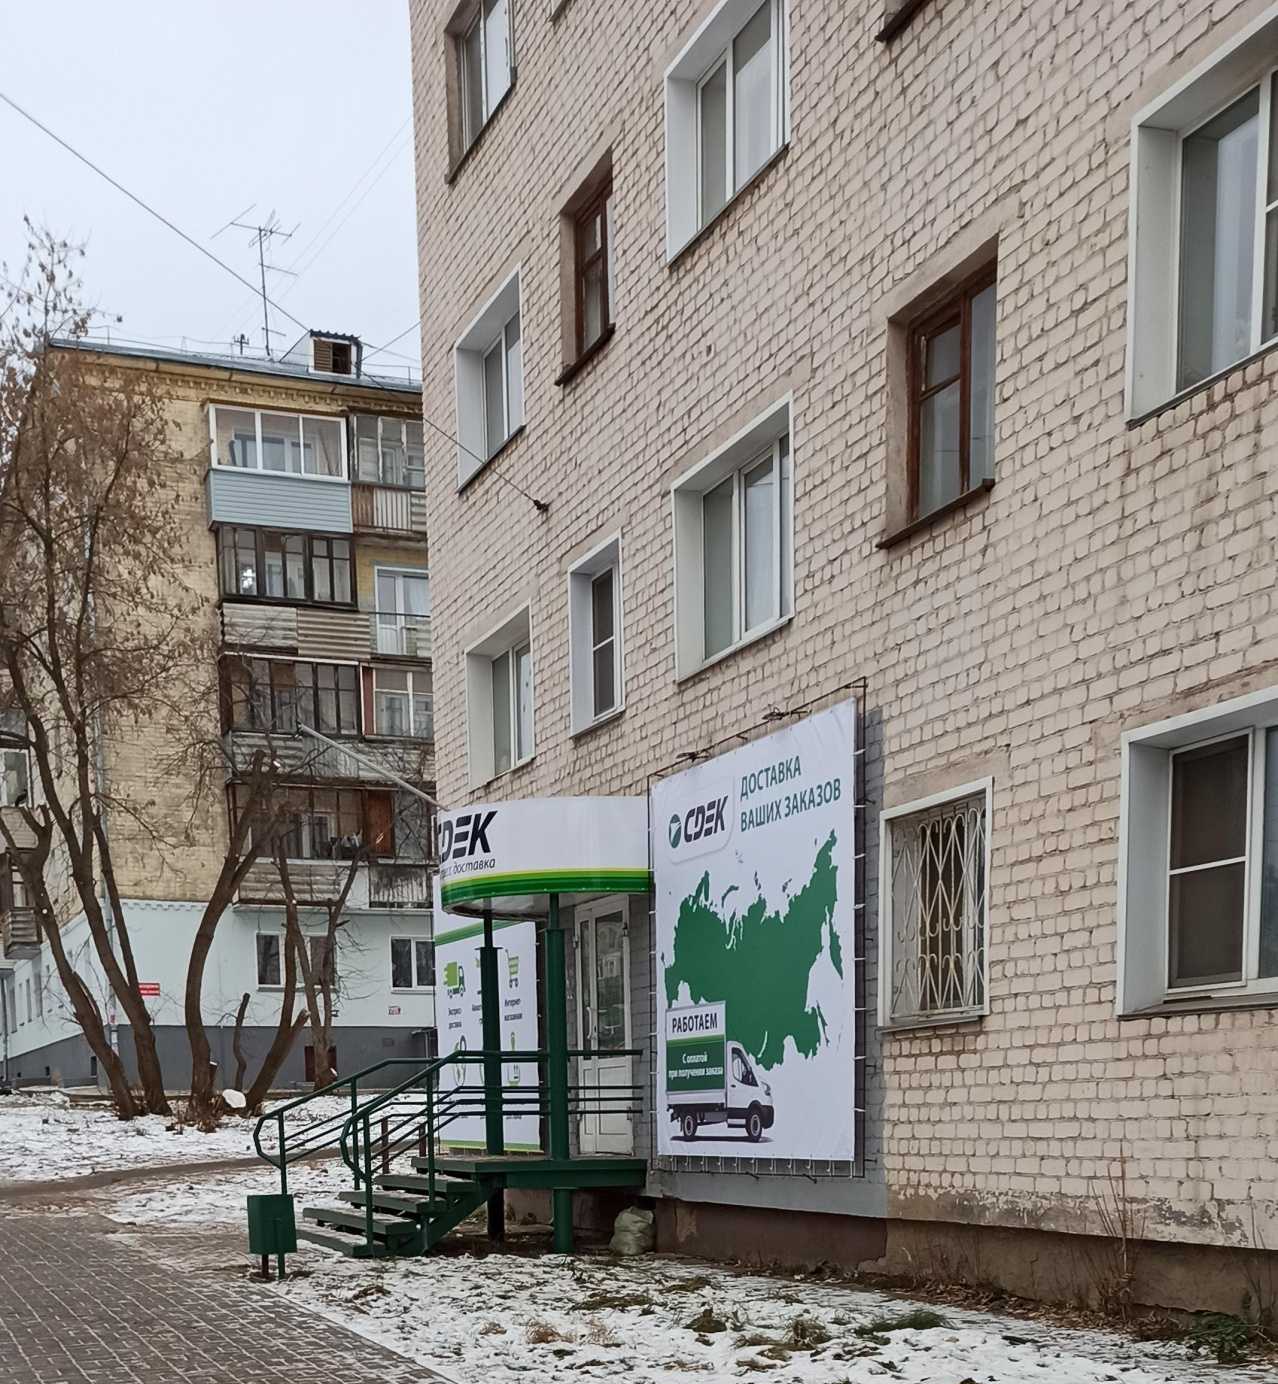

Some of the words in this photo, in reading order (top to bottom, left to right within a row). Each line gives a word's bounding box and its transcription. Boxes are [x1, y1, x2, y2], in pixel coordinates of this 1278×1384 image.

[740, 755, 801, 801] ДОСТАВКА
[684, 795, 729, 843] CDEK
[741, 799, 782, 832] ВАШИХ
[784, 778, 841, 818] ЗАКАЗОВ
[672, 1012, 718, 1033] РАБОТАЕМ
